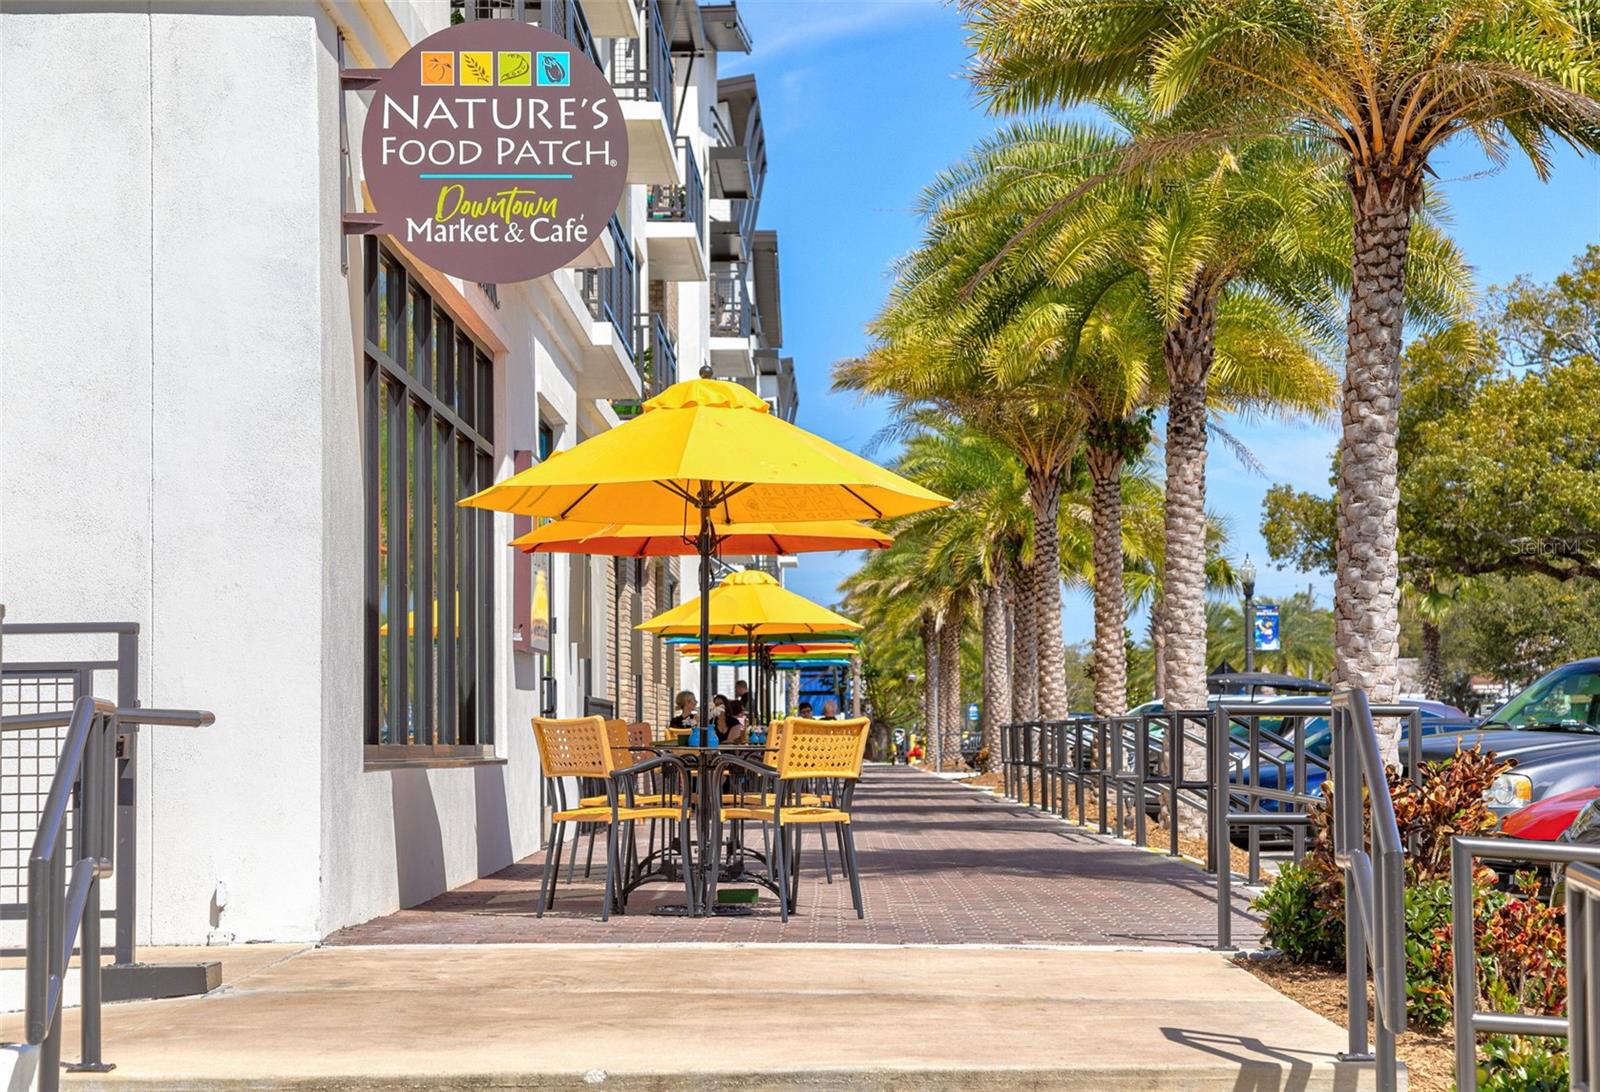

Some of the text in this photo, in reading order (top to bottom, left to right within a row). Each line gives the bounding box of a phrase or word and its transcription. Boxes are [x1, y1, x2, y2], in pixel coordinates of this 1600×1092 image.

[383, 94, 608, 129] NATURE'S
[383, 137, 482, 165] FOOD
[434, 184, 558, 224] Downtown
[406, 214, 587, 242] Market & Café
